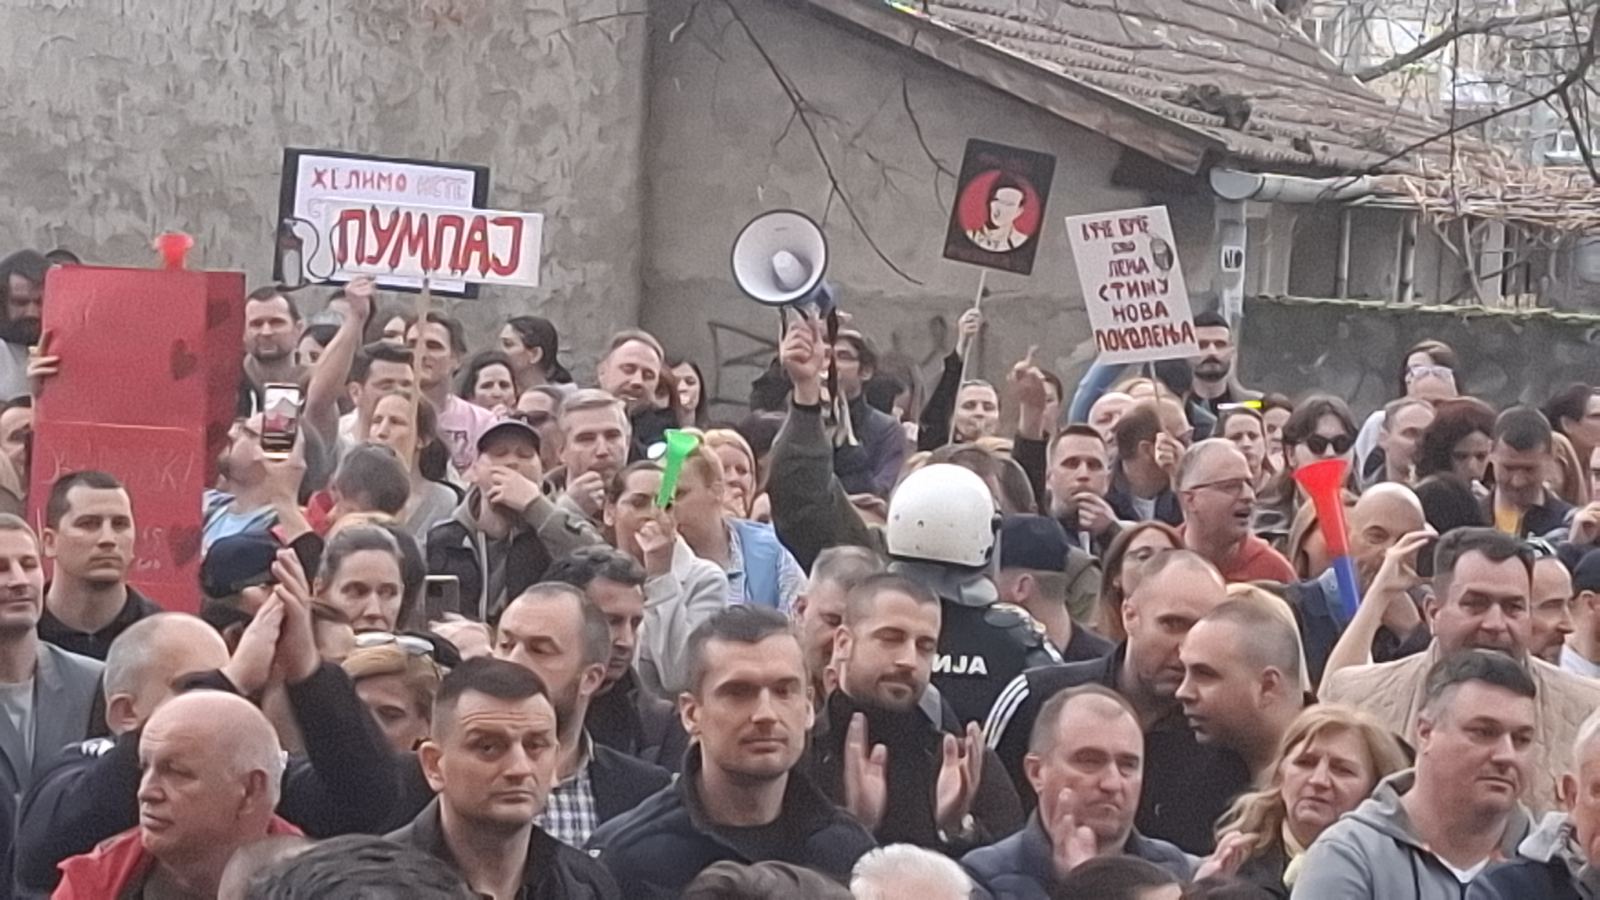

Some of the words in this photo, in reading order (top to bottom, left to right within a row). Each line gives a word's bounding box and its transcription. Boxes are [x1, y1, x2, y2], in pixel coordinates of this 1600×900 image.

[336, 204, 523, 278] ПУМПАЈ
[1111, 301, 1168, 322] НОВА
[1095, 320, 1195, 352] ПОКОЛЕЊА
[932, 653, 988, 675] ИЈА
